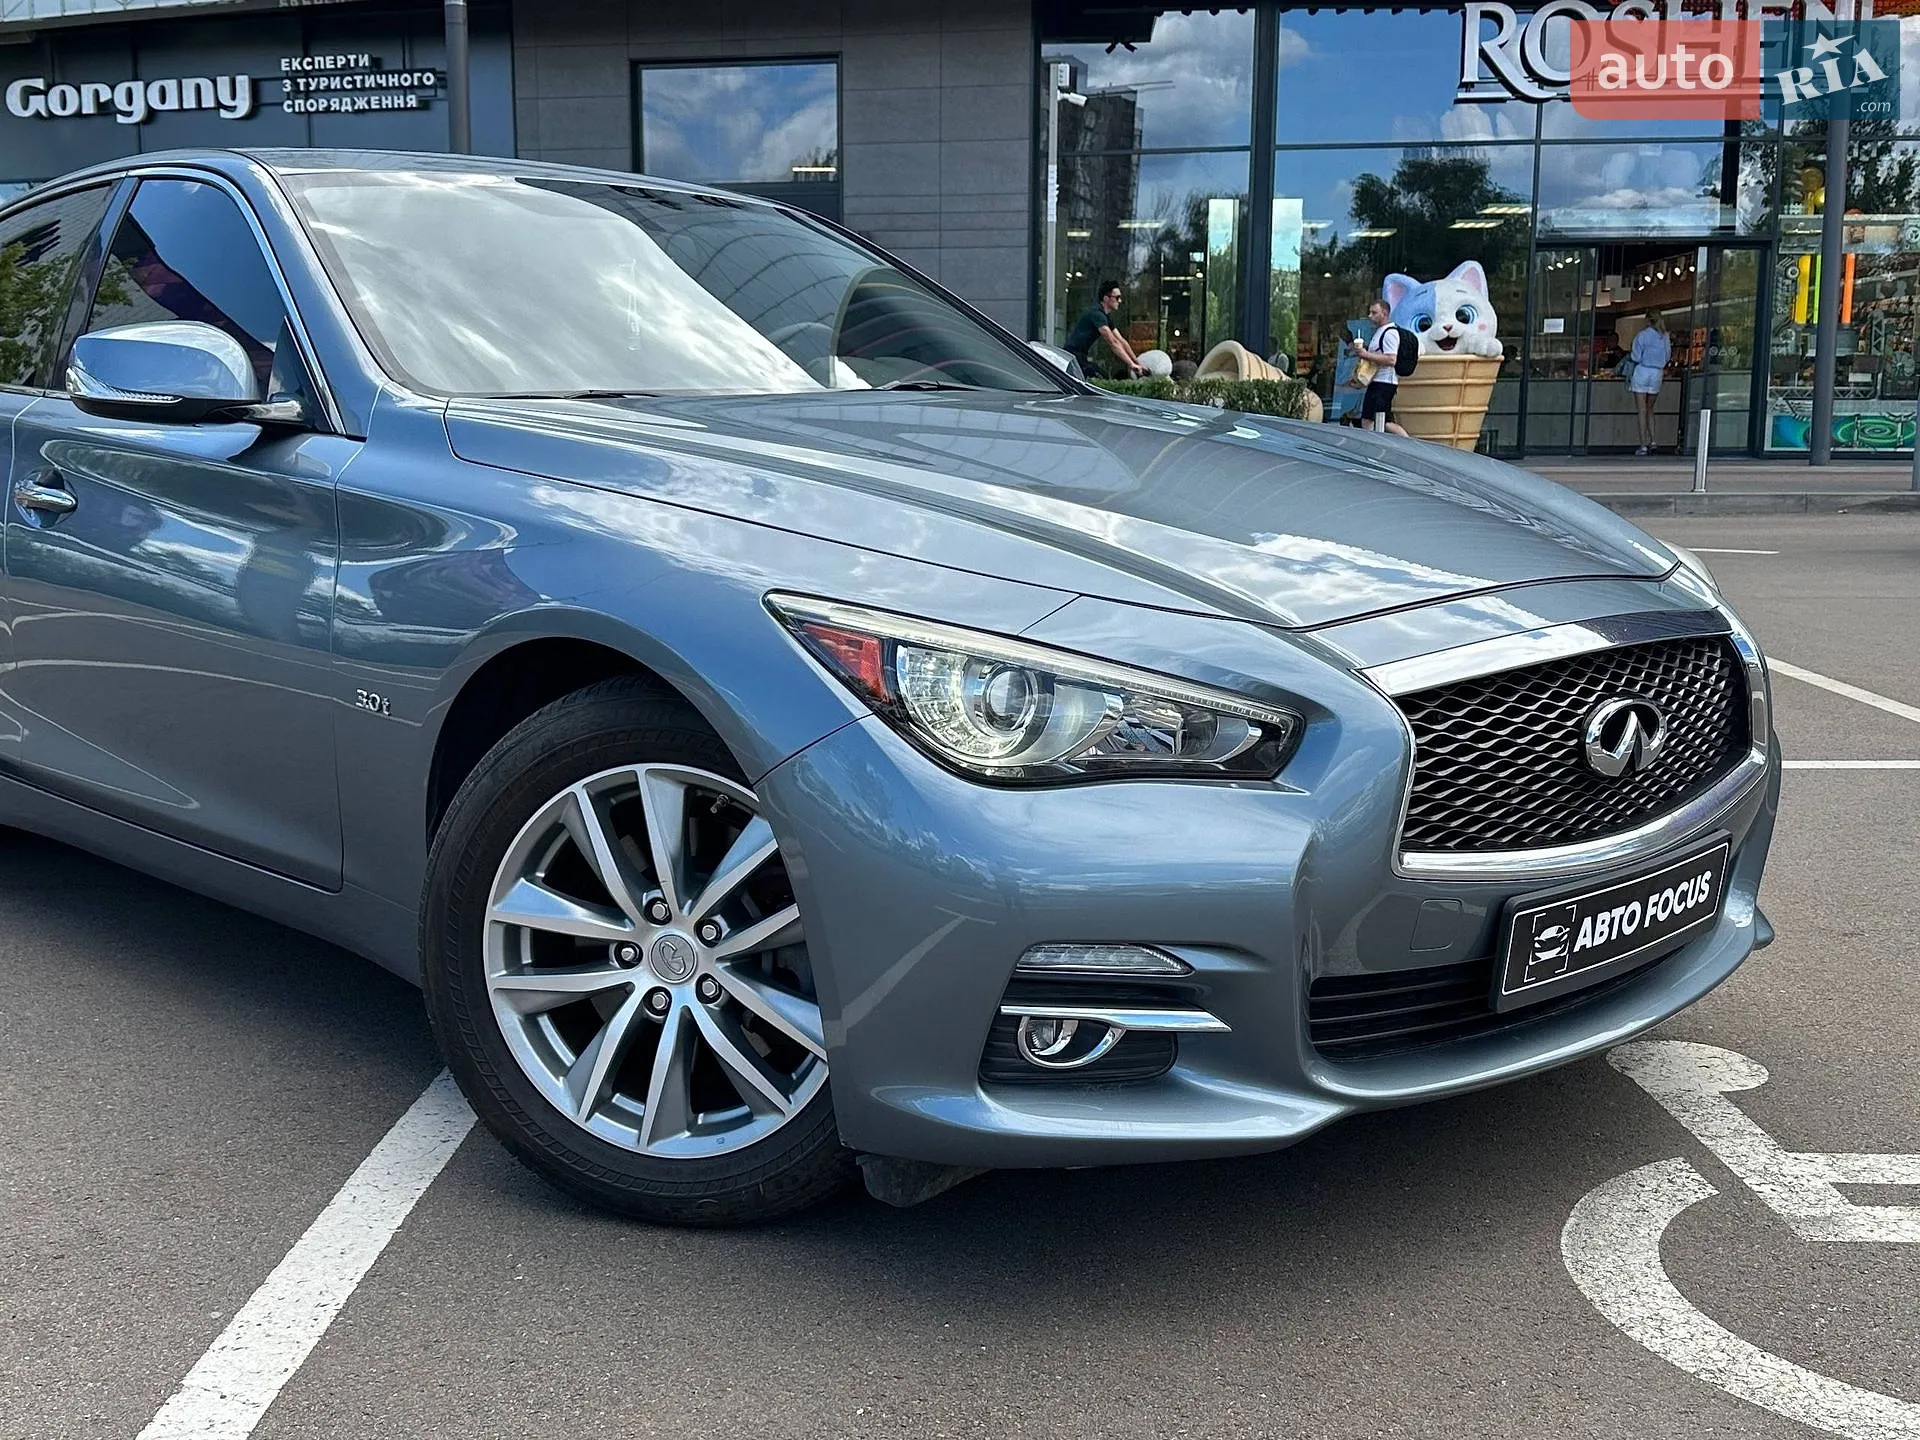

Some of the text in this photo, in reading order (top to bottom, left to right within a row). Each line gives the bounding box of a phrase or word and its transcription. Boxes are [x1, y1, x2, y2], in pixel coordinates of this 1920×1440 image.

[280, 54, 370, 71] ЕКСПЕРТИ
[297, 72, 435, 92] ТУРИСТИЧНОГО
[5, 75, 250, 124] Gorgany
[282, 94, 418, 113] СПОРЯДЖЕННЯ
[1573, 870, 1713, 953] АВТО FOCUS
